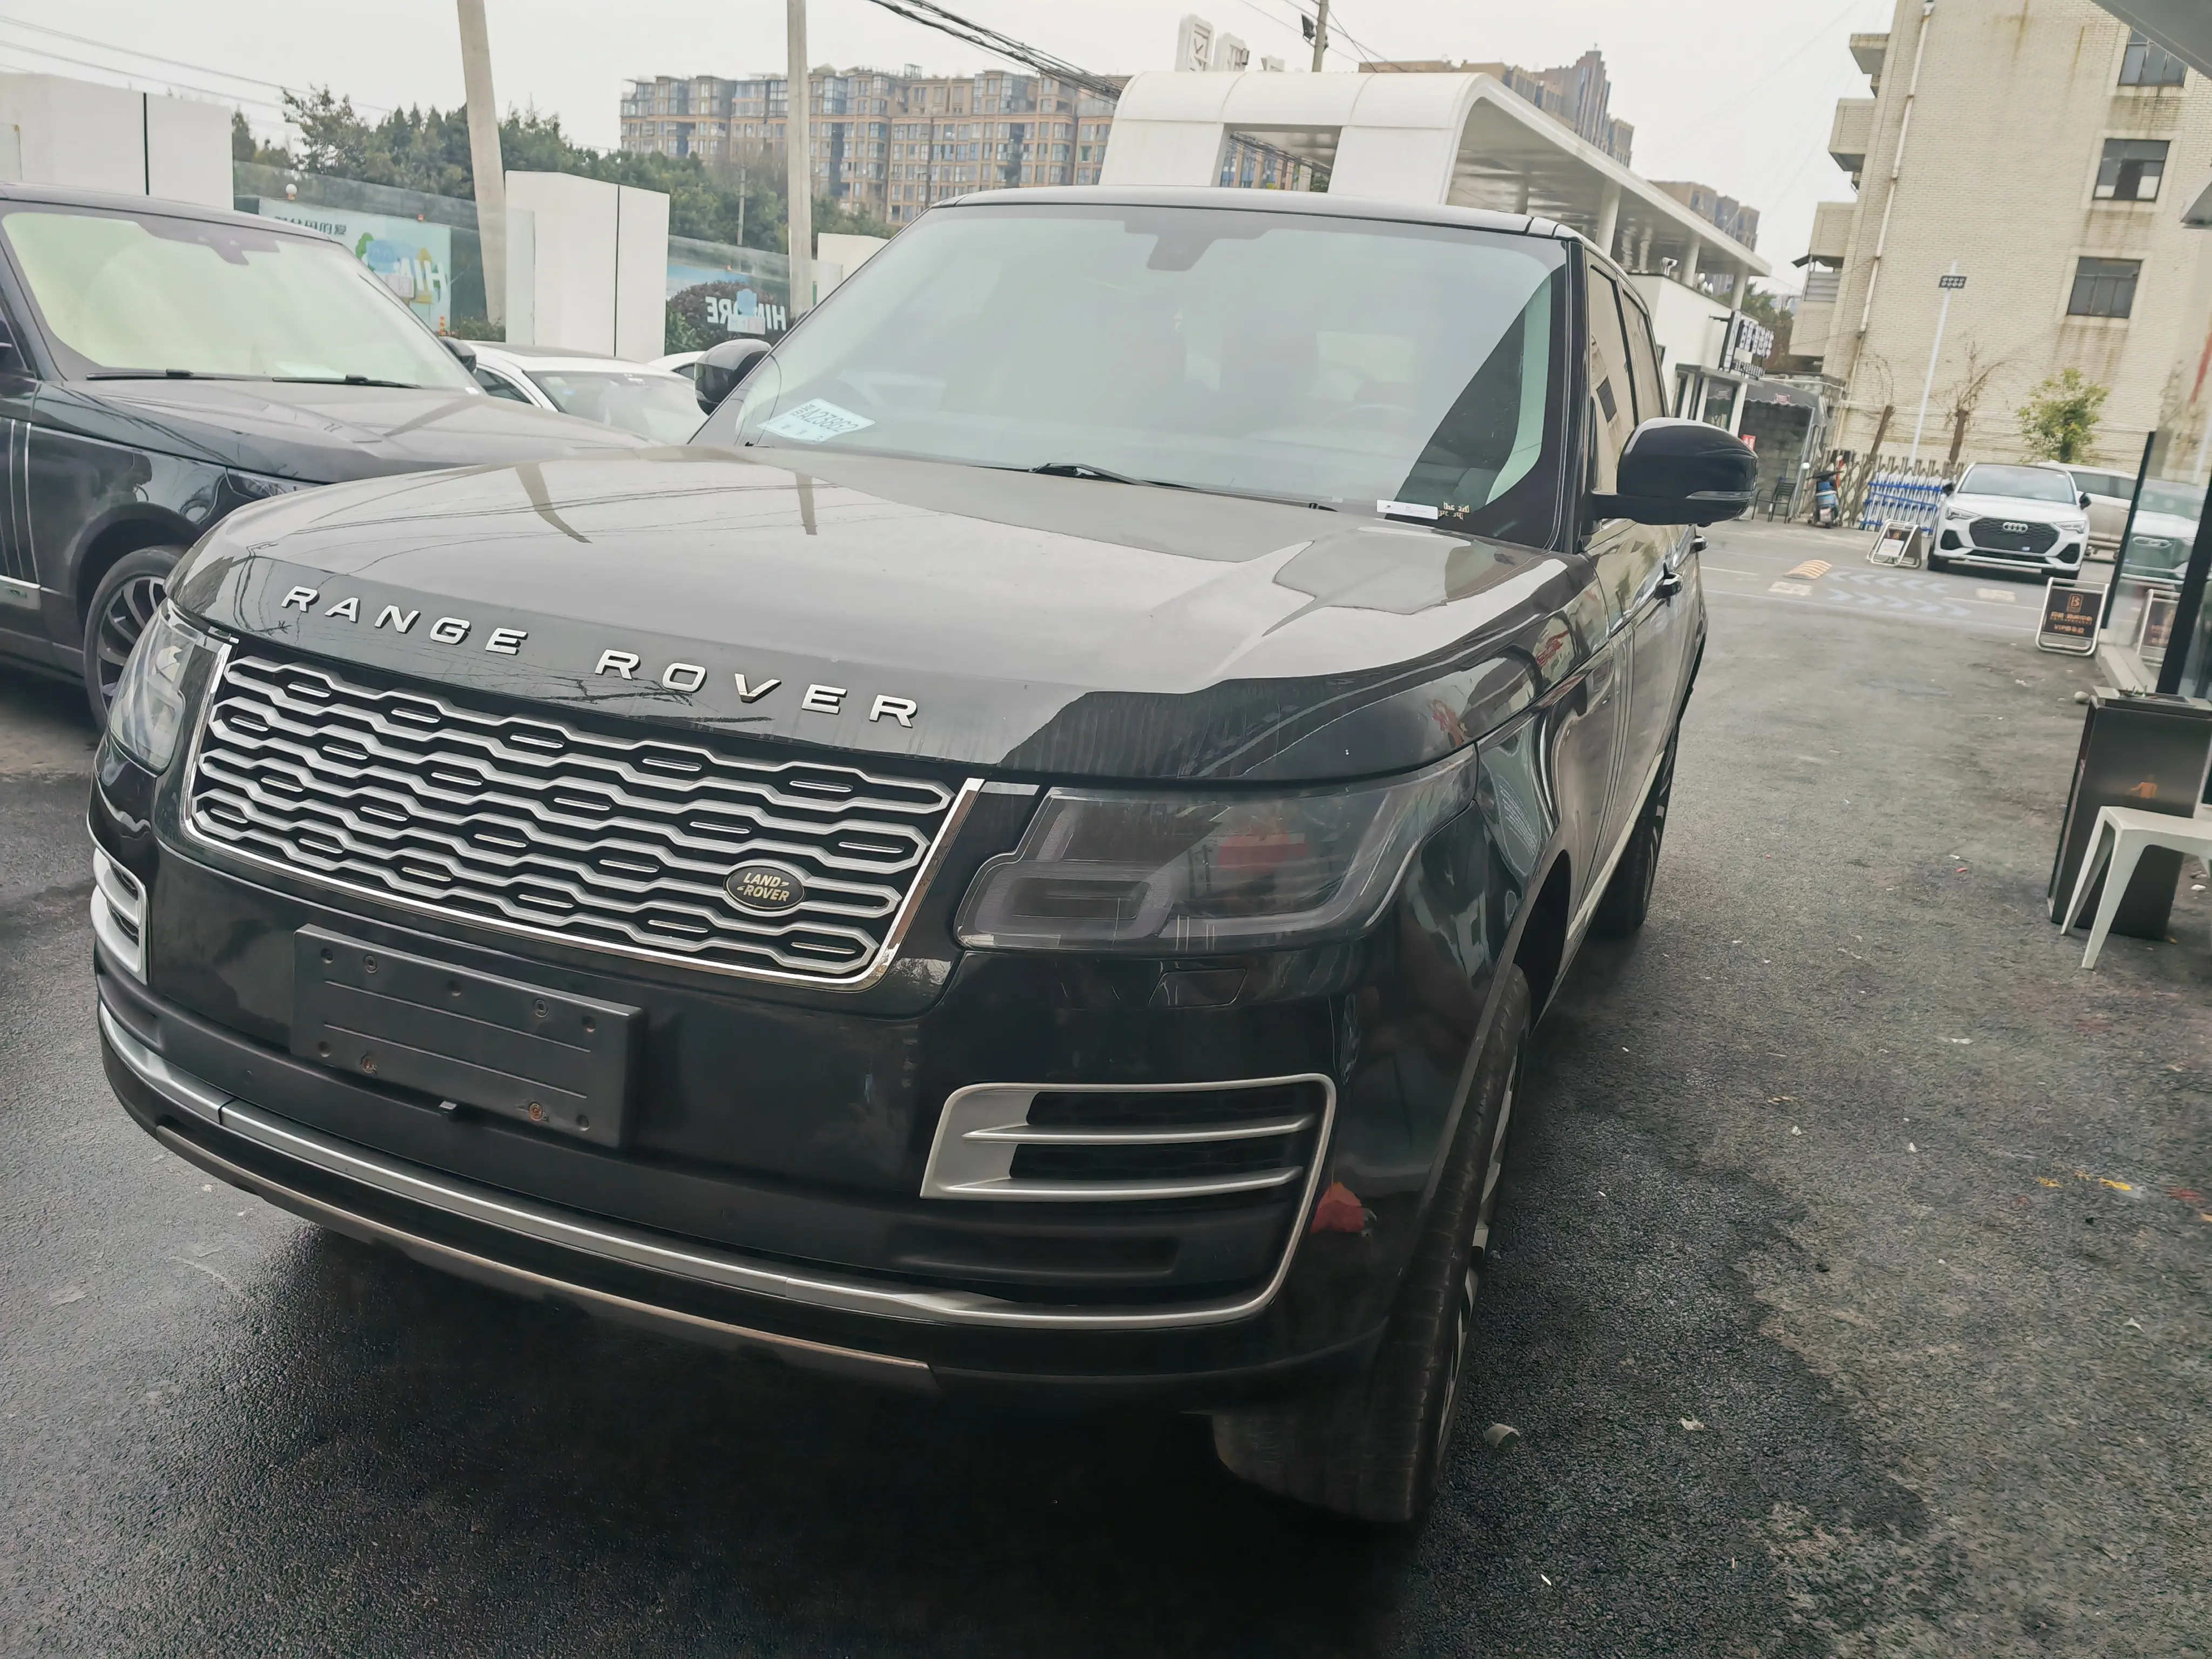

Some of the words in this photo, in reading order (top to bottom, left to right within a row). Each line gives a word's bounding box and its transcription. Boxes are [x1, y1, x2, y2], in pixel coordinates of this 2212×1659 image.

[281, 585, 529, 656] RANGE
[595, 649, 918, 728] ROVER
[743, 872, 781, 888] LAND
[743, 885, 790, 902] ROVER
